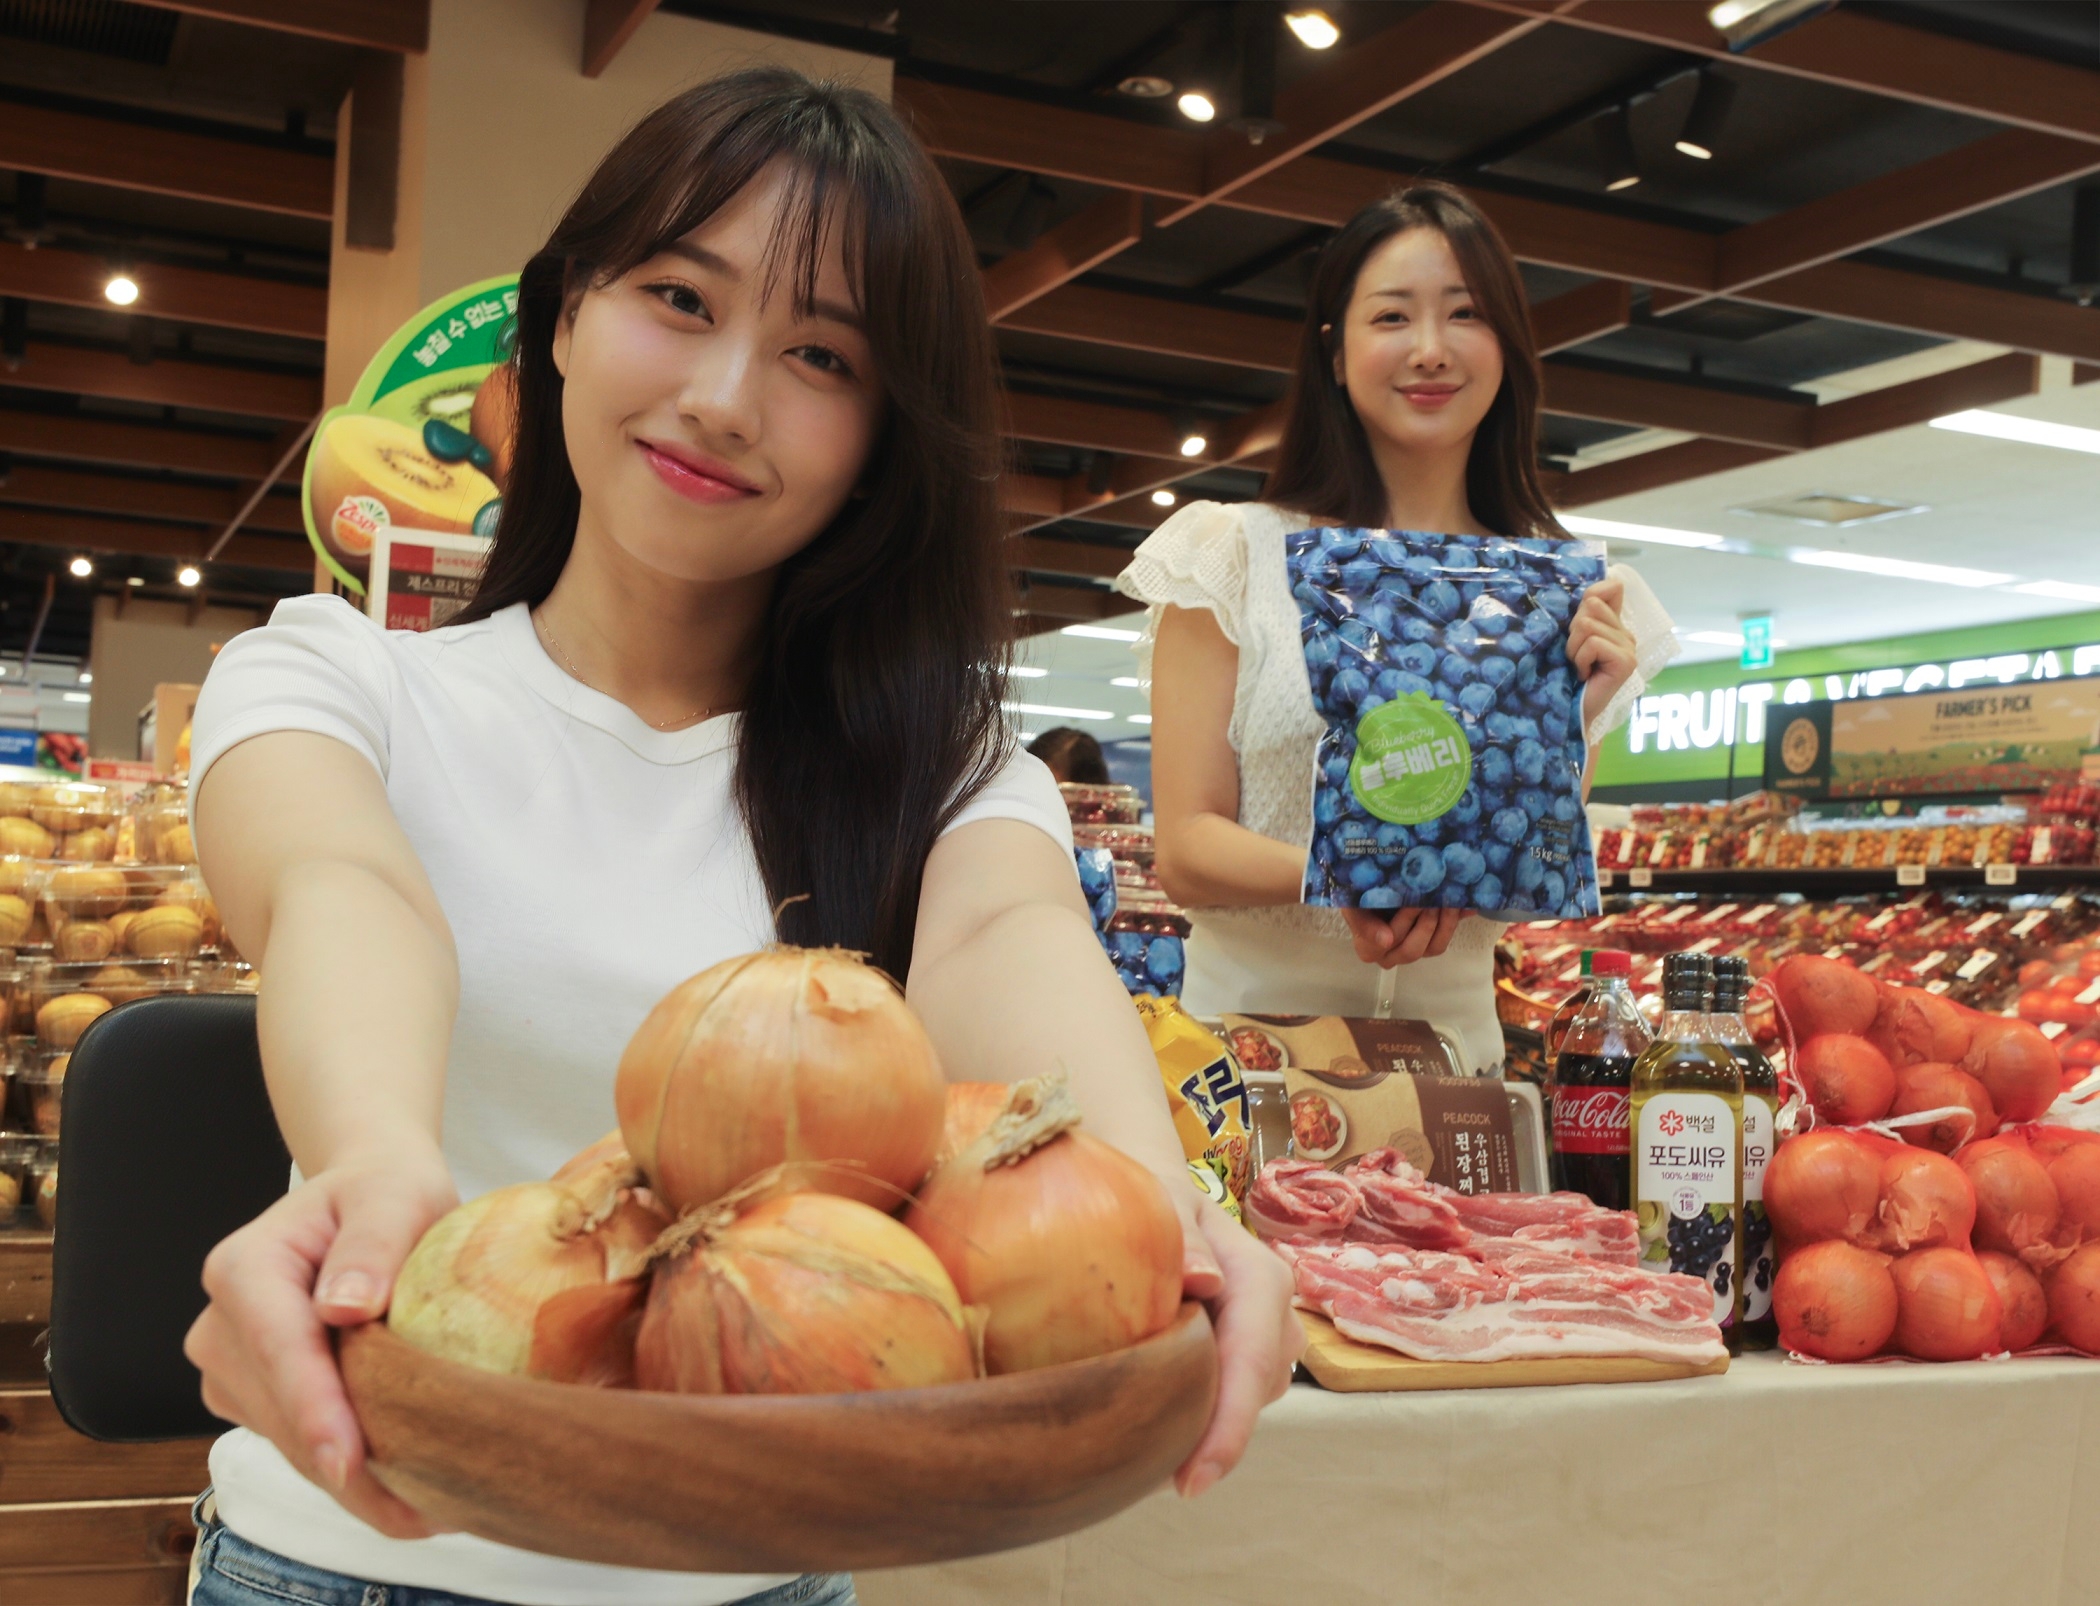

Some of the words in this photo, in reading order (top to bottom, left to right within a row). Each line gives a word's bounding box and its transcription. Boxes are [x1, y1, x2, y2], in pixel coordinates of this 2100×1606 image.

[448, 317, 468, 340] 수
[463, 299, 505, 330] 없는
[1629, 682, 1773, 754] FRUIT
[1935, 697, 1998, 720] FARMER'S
[2001, 694, 2033, 715] PICK
[1359, 736, 1461, 792] 블루베리
[1442, 1111, 1491, 1126] PEACOCK
[1685, 1114, 1716, 1134] 백설
[1743, 1115, 1756, 1134] 설
[1591, 1130, 1621, 1138] TASTE
[1454, 1131, 1474, 1196] 된장찌
[1648, 1145, 1726, 1169] 포도씨유
[1660, 1171, 1683, 1181] 100%
[1679, 1199, 1694, 1212] 1등
